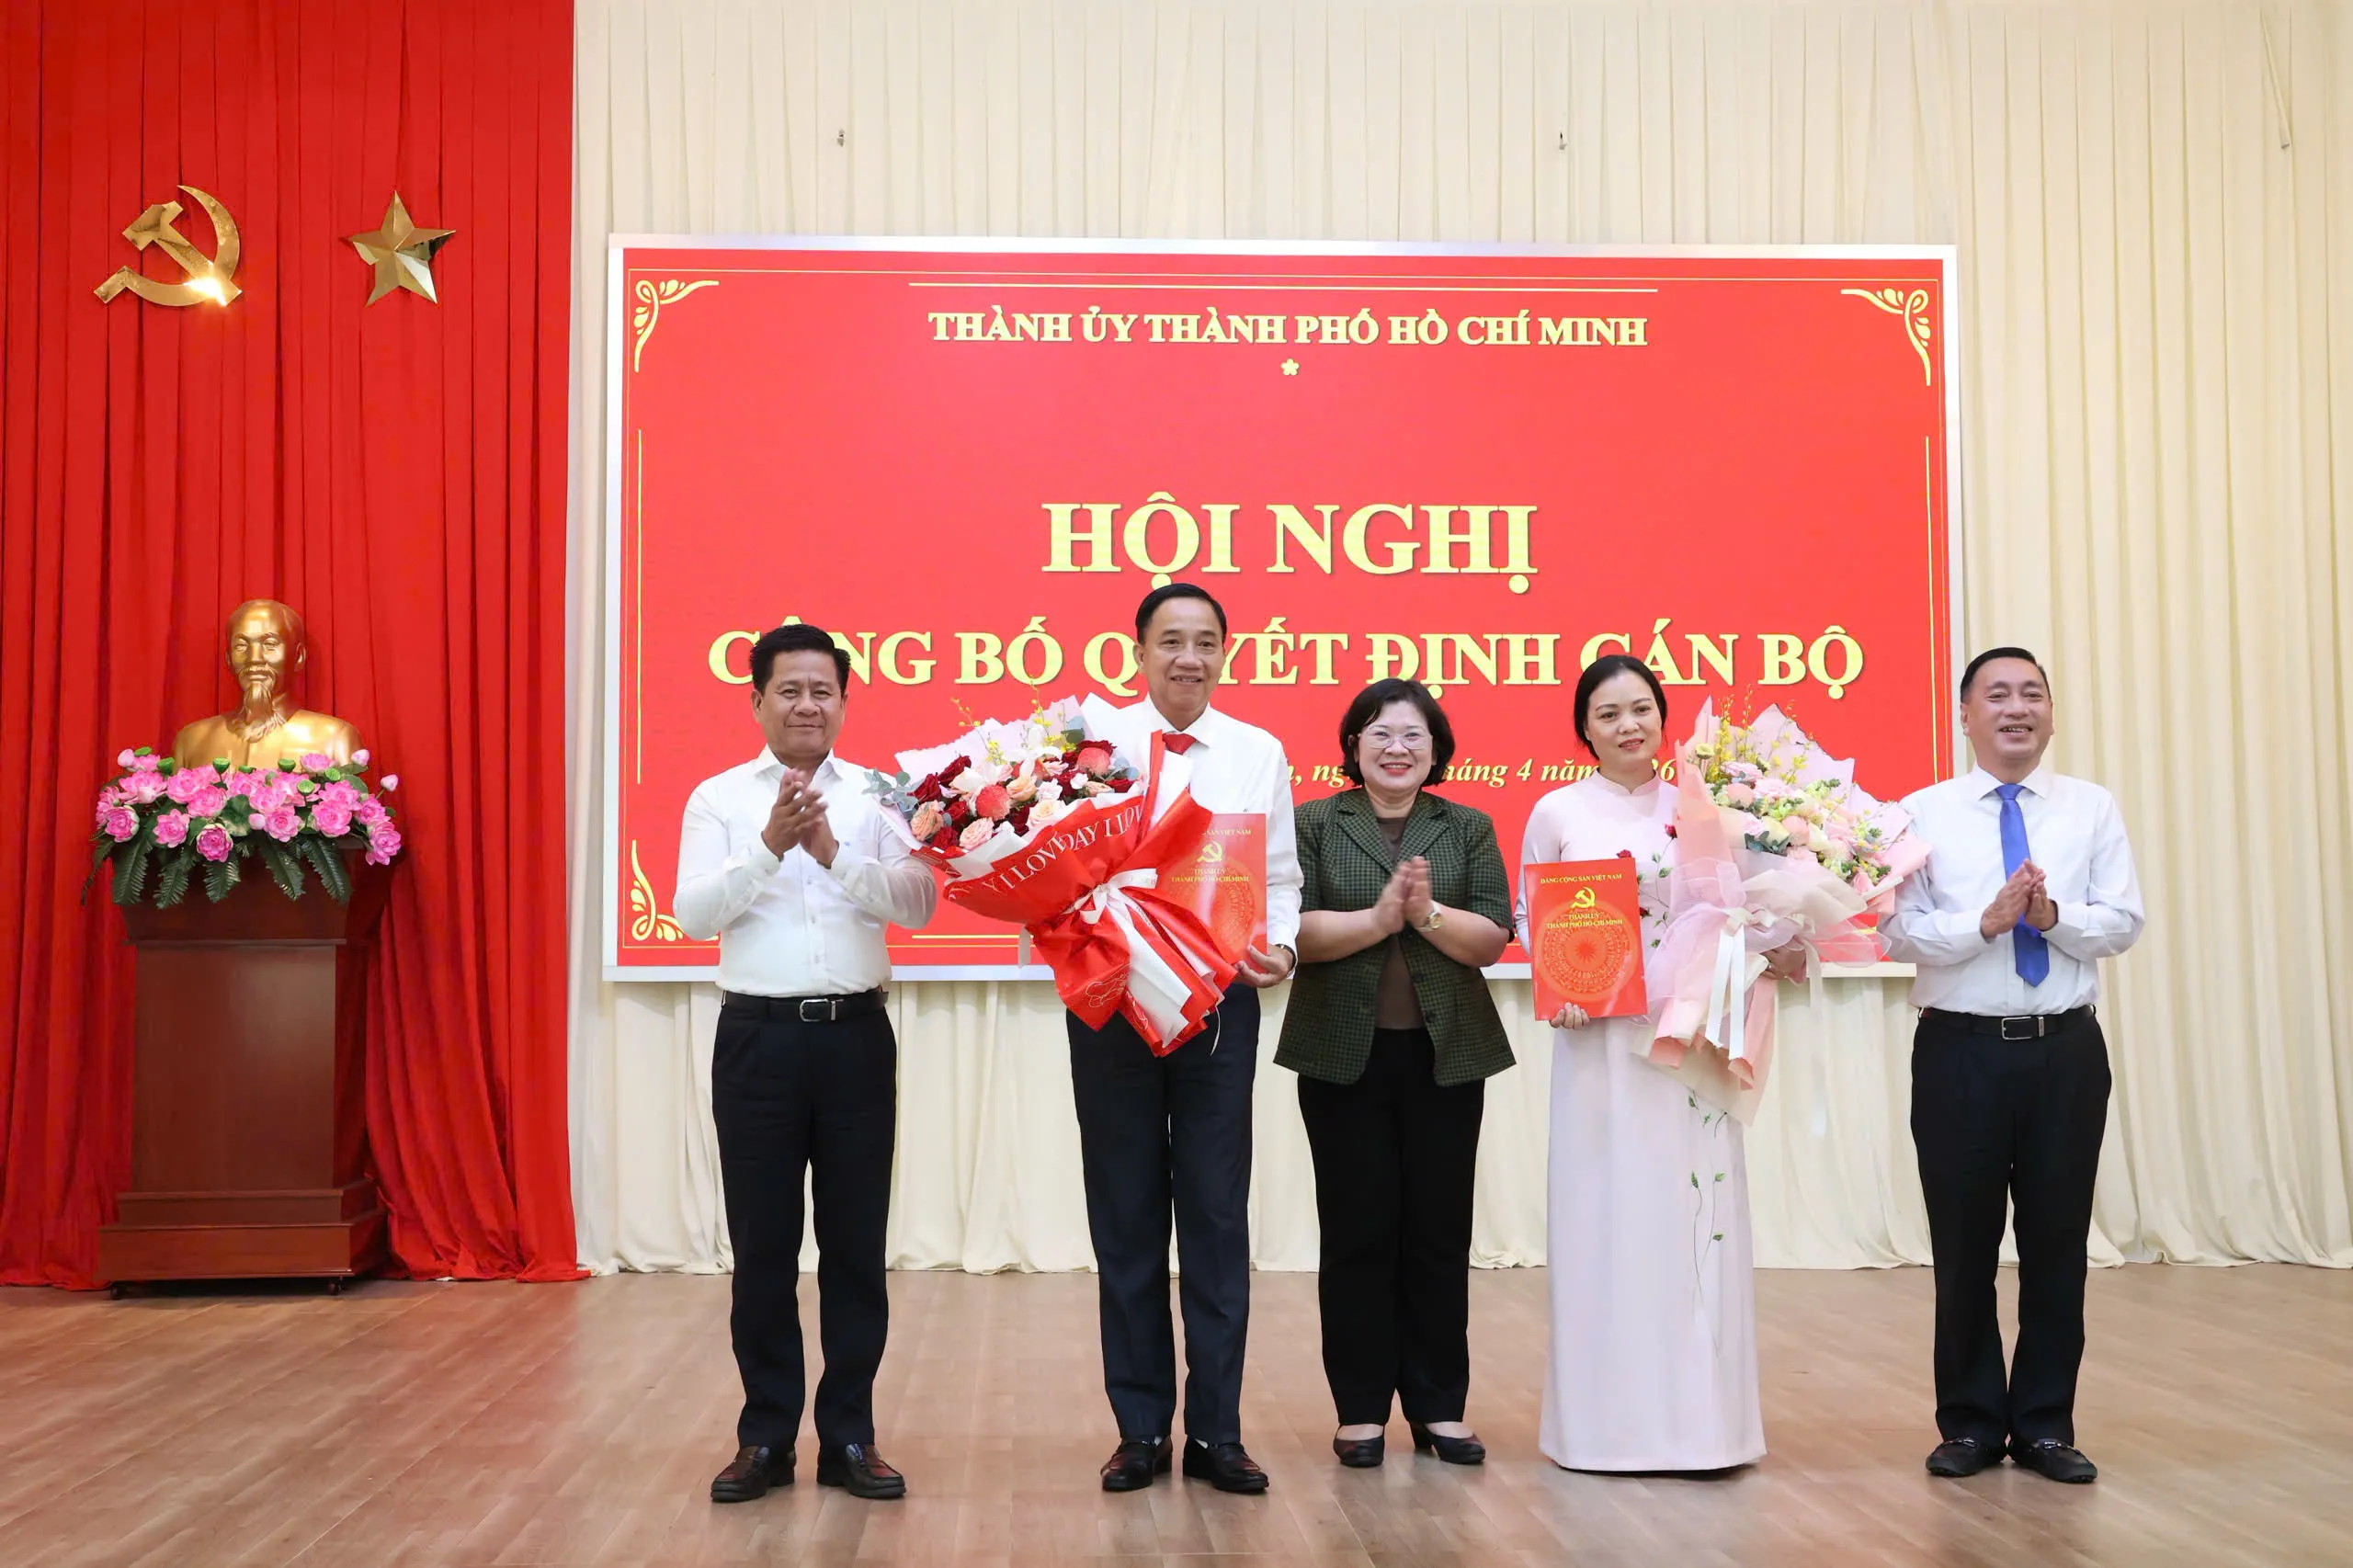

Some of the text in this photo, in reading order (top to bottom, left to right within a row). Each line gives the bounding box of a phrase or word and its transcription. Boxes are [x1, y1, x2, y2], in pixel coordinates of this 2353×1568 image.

[927, 304, 1648, 347] THÀNH ỦY THÀNH PHỐ HỒ CHÍ MINH
[1041, 491, 1539, 594] HỘI NGHỊ
[708, 616, 1864, 699] CNG BỐ QYẾT ĐỊNH CÁN BỘ
[1517, 758, 1533, 781] 4
[1540, 759, 1599, 781] năm
